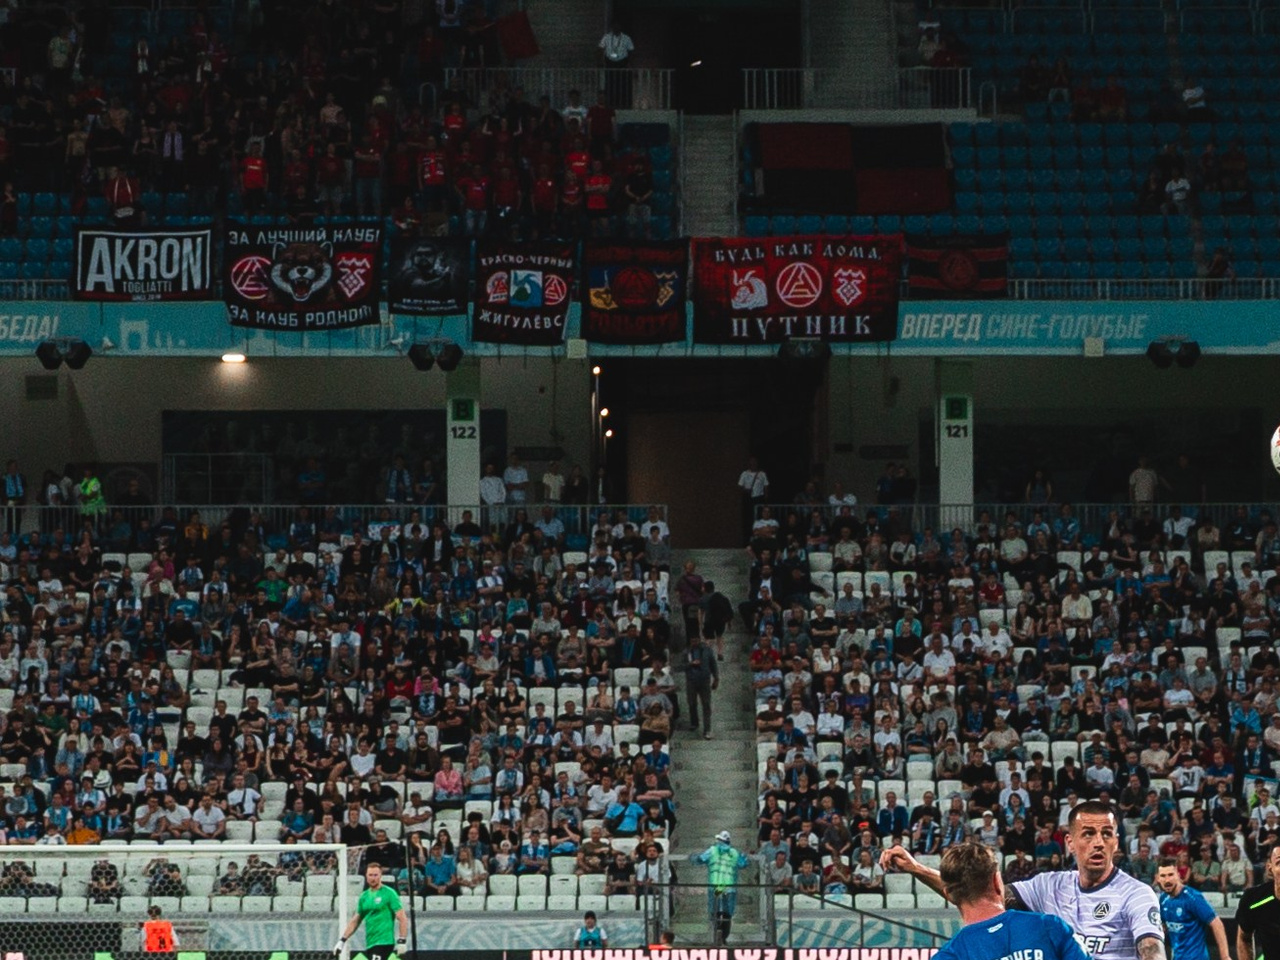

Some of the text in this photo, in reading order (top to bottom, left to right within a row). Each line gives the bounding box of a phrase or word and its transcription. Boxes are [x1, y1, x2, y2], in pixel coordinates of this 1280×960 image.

[228, 227, 381, 245] ЗА ЛУЧШИЙ КЛУБ!
[714, 246, 765, 263] БУДЬ
[774, 242, 813, 256] КАК
[85, 237, 203, 292] AKRON
[122, 281, 172, 293] TOGLIATTI
[228, 304, 250, 322] ЗА
[256, 311, 298, 327] КЛУБ
[731, 315, 871, 341] ПУТНИК
[901, 313, 1148, 341] ВПЕРЕД СИНЕ-ГОЛУБЫЕ
[451, 426, 477, 440] 122
[945, 424, 969, 438] 121
[1073, 932, 1110, 955] ET
